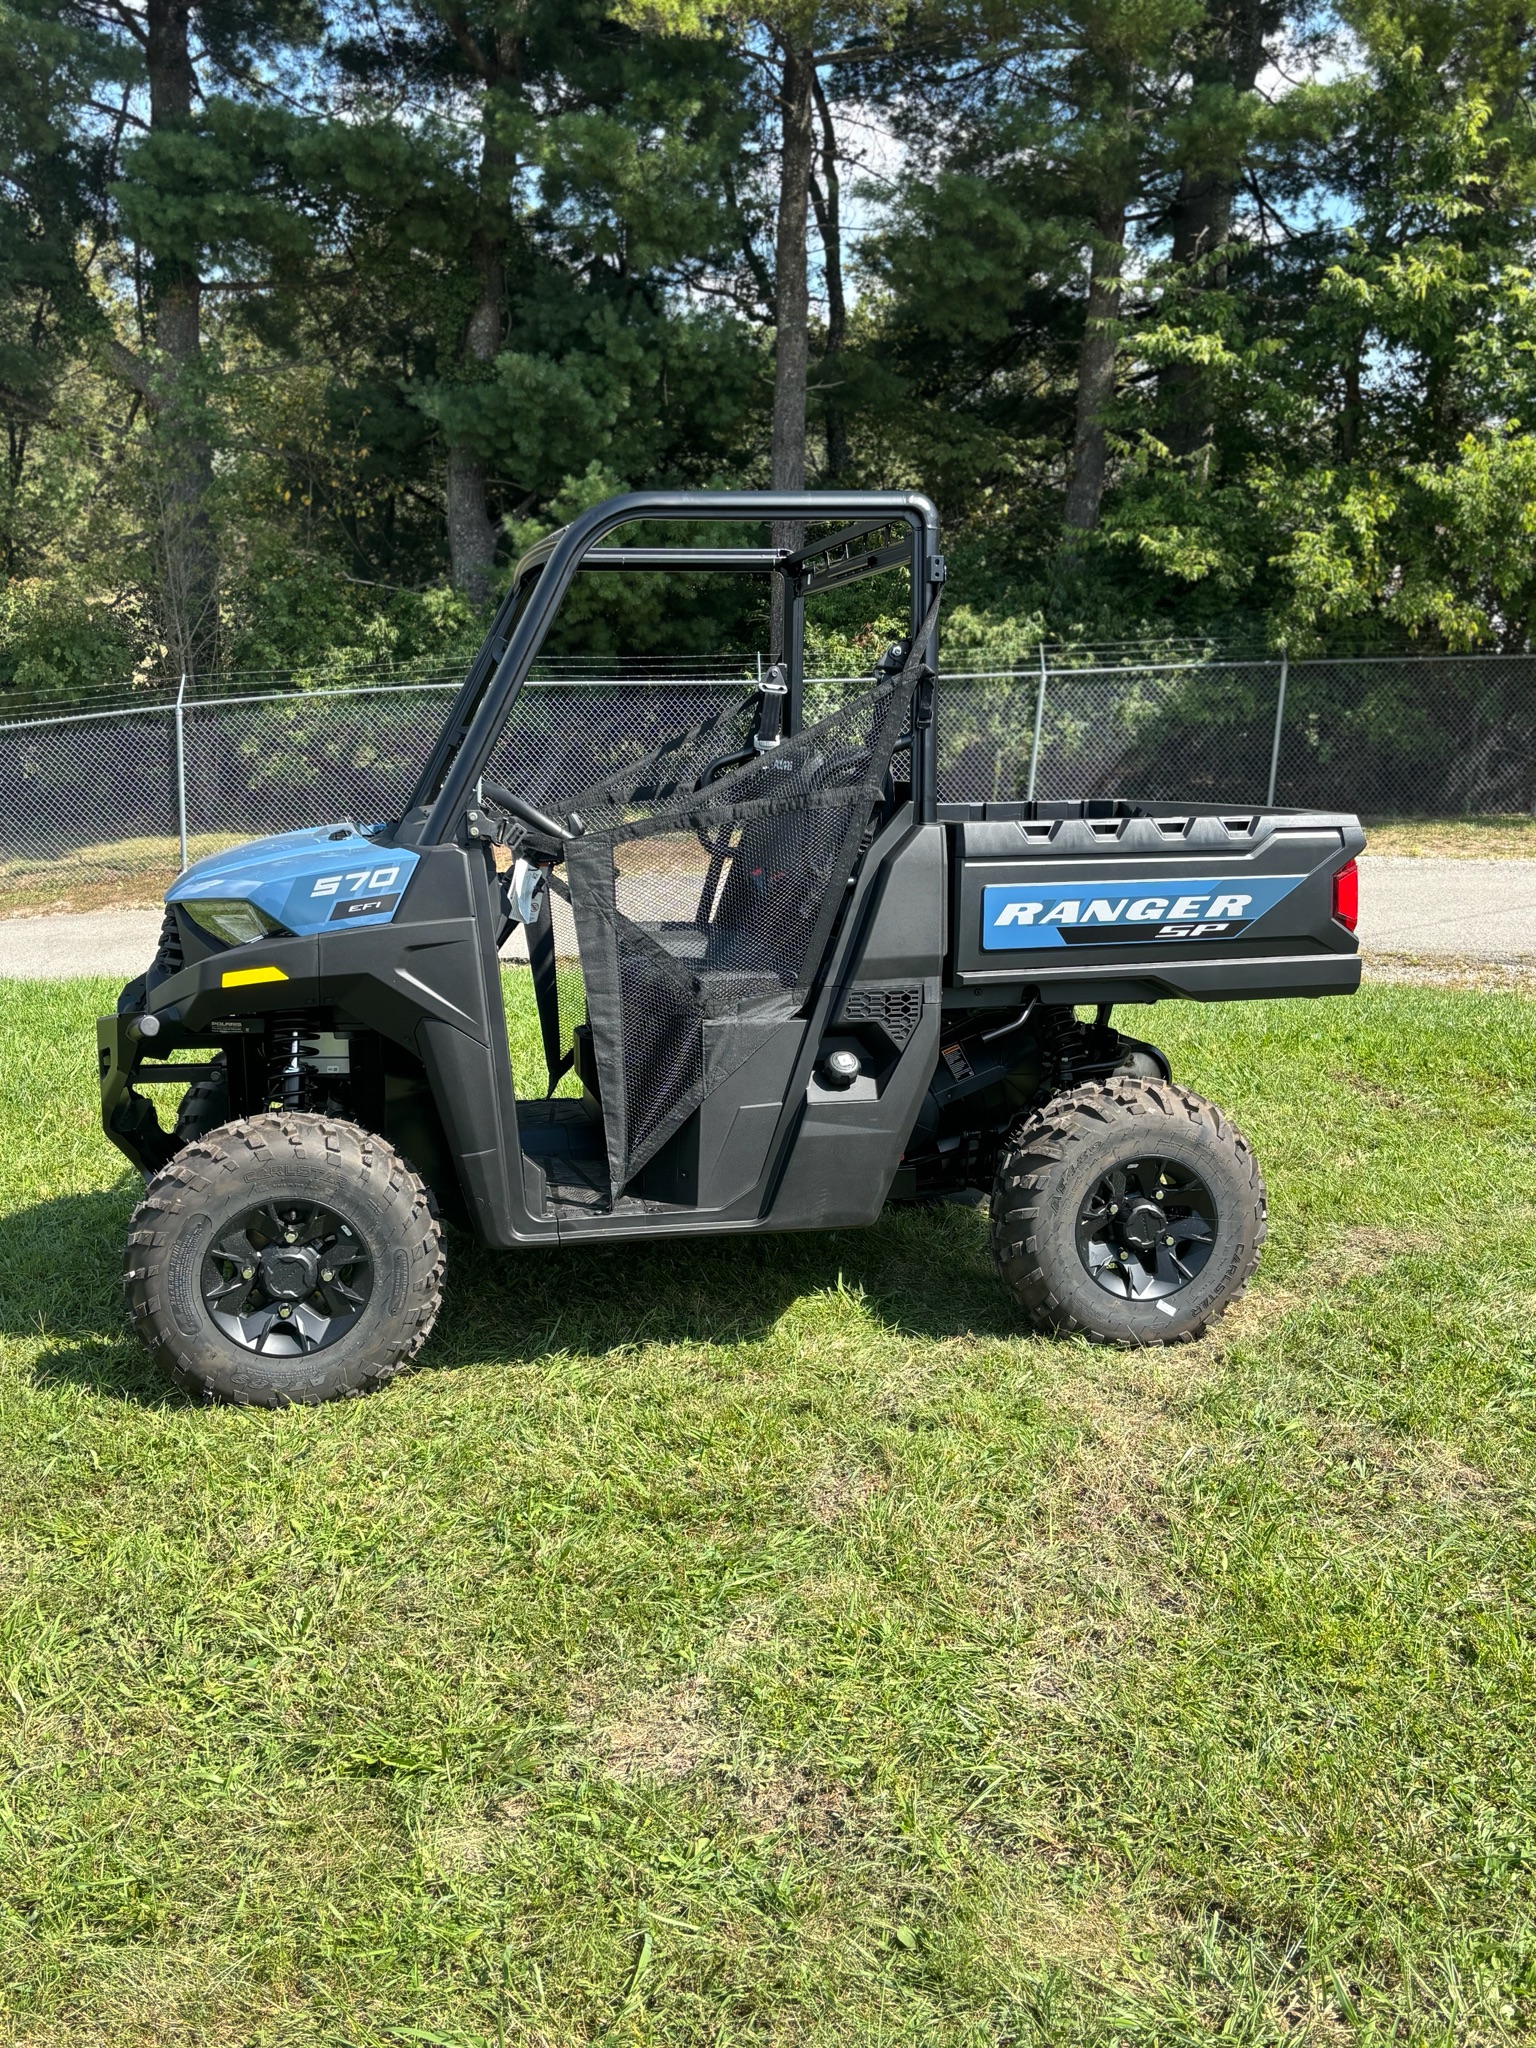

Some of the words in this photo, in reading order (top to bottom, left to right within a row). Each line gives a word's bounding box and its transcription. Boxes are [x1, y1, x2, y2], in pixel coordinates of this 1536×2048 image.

[310, 867, 400, 898] 570
[348, 901, 381, 912] EFI
[993, 894, 1252, 926] RANGER
[1154, 923, 1230, 939] SP
[243, 1164, 348, 1189] CARLSTAR
[1190, 1243, 1245, 1318] CARLSTAR
